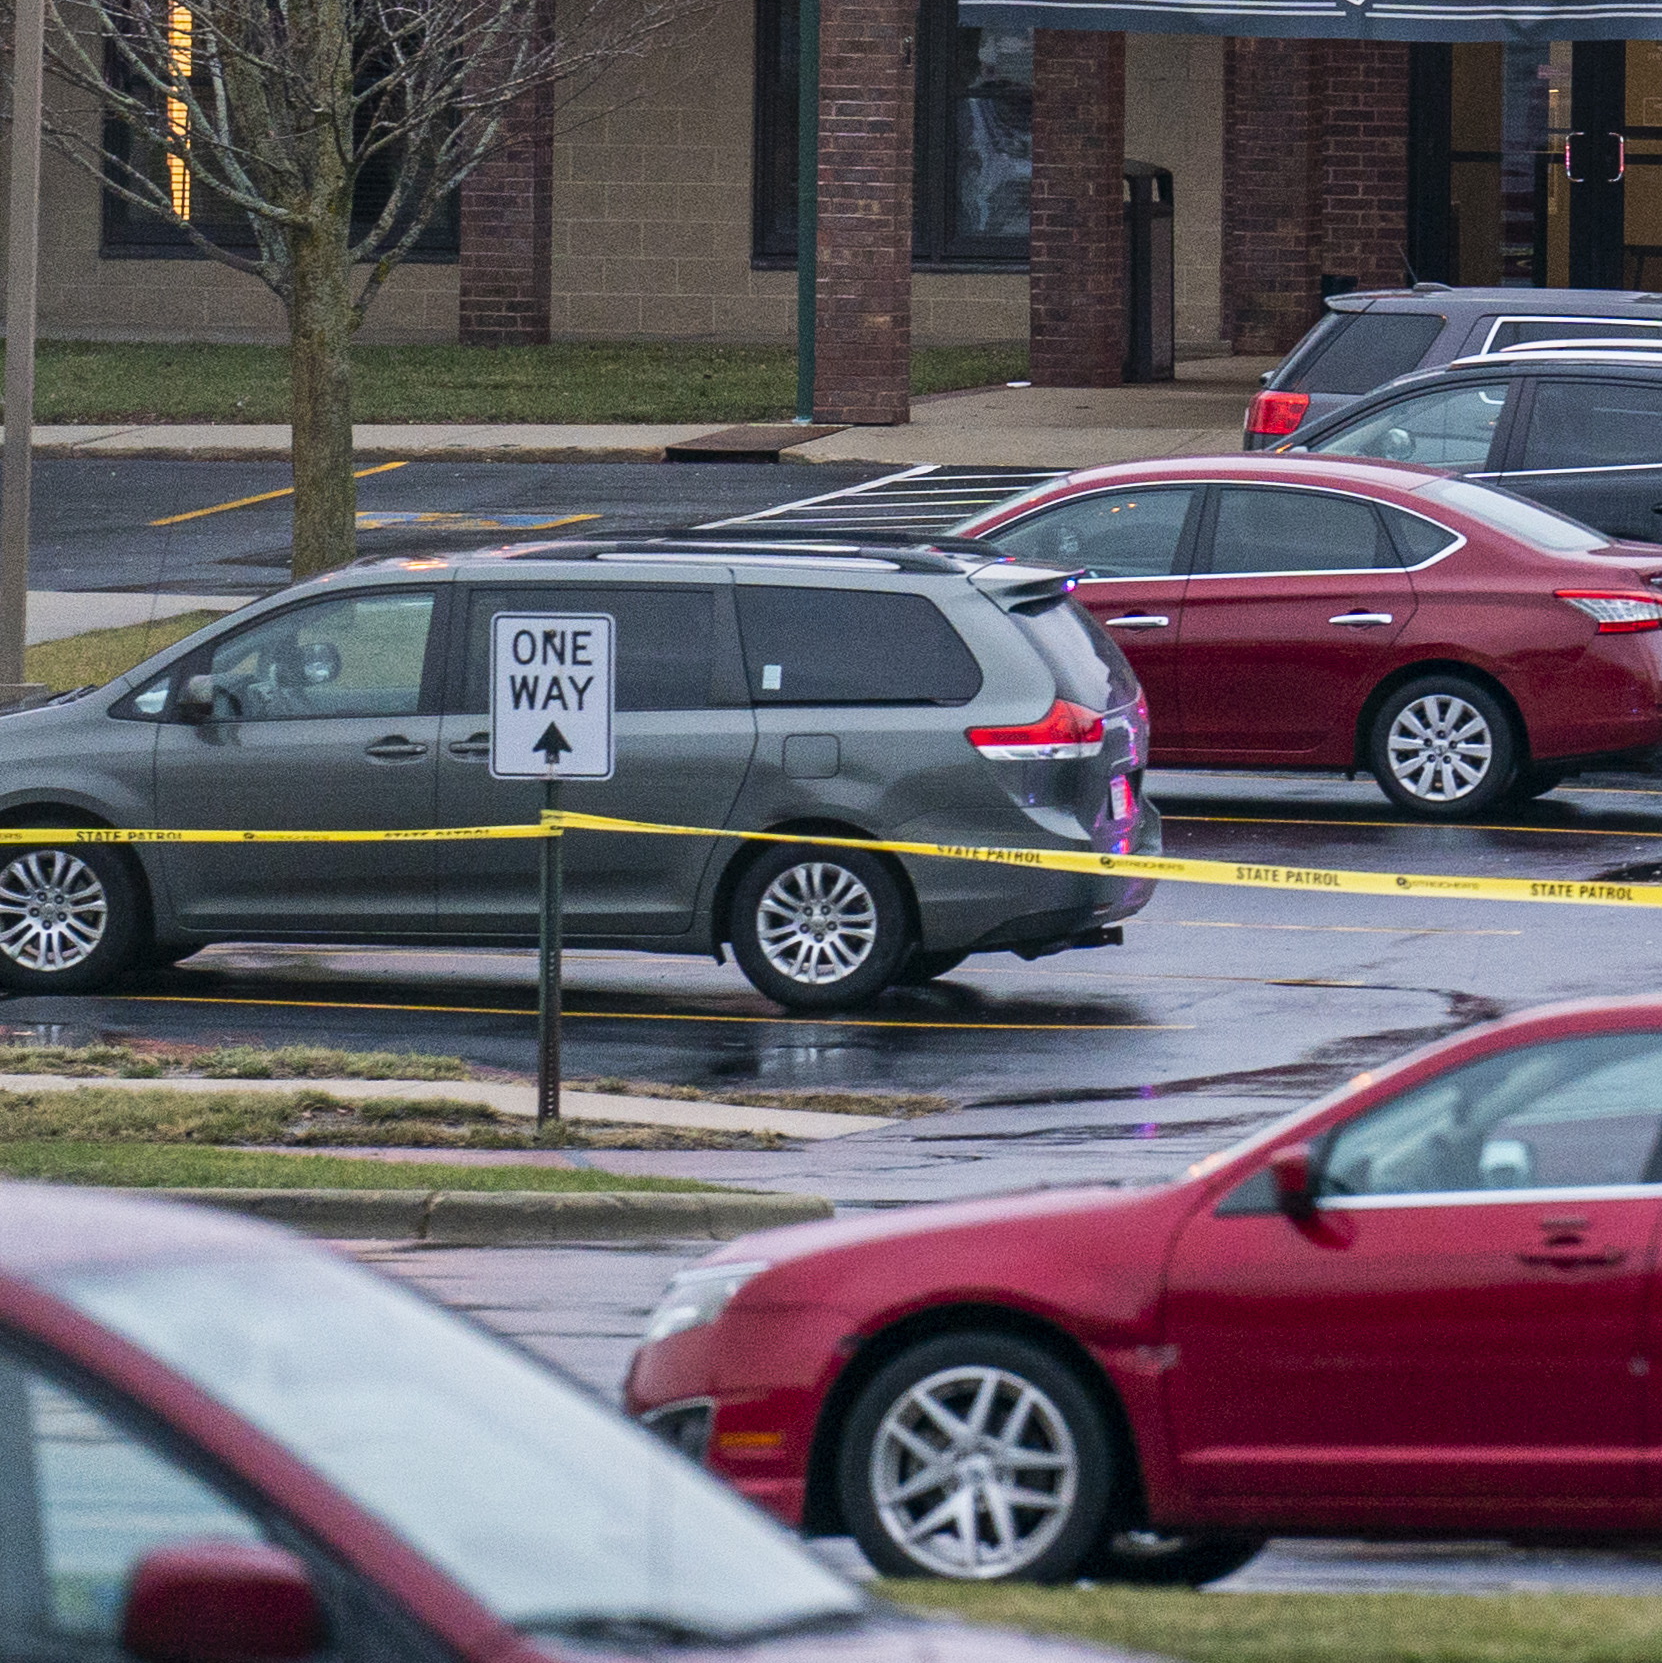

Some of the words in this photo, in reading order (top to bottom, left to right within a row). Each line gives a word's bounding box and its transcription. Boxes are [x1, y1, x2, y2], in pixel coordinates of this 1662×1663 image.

[512, 629, 593, 666] ONE
[510, 674, 594, 711] WAY
[986, 849, 1043, 865] PATROL
[1236, 866, 1279, 883] STATE
[1285, 870, 1341, 887] PATROL
[1530, 883, 1573, 898] STATE
[1579, 886, 1634, 901] PATROL
